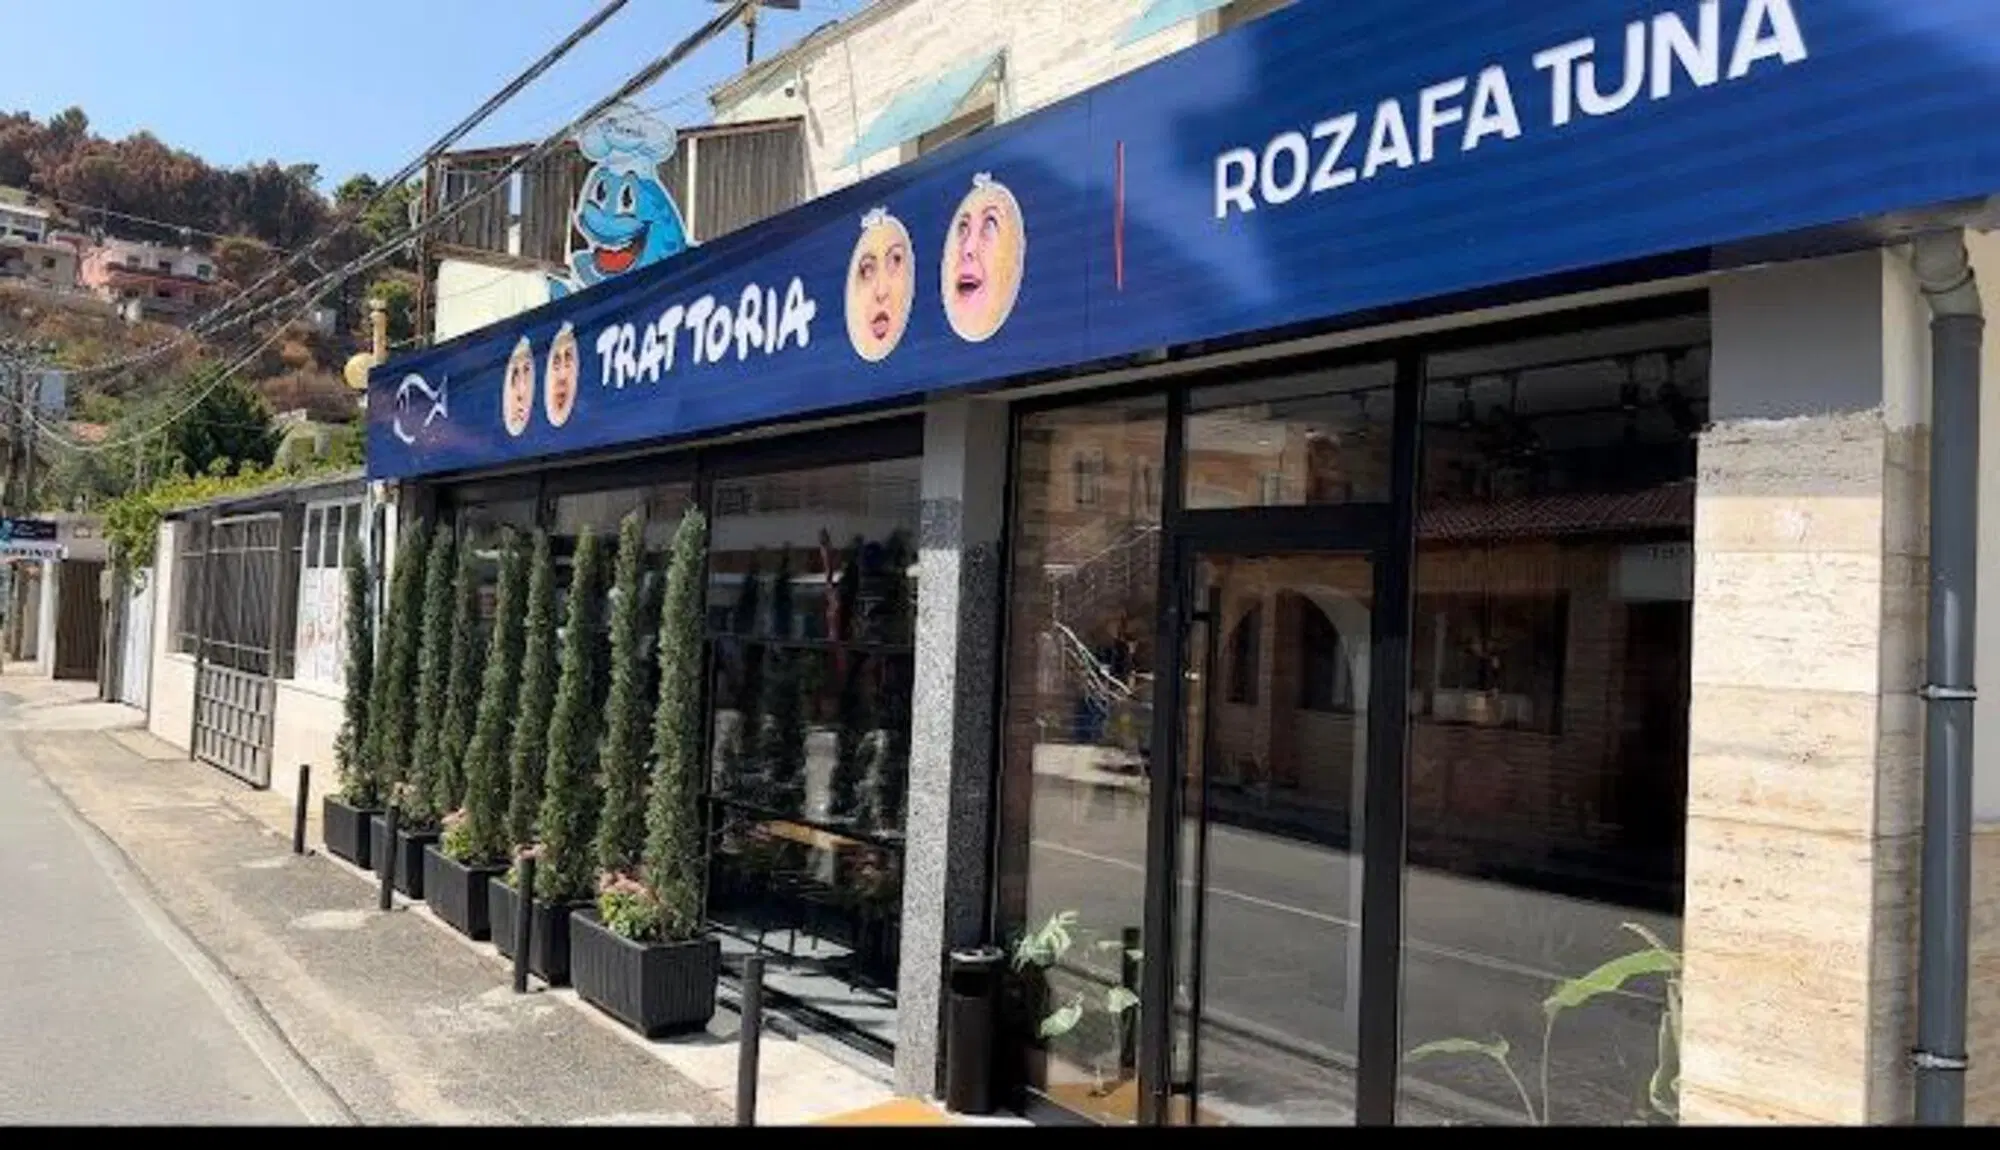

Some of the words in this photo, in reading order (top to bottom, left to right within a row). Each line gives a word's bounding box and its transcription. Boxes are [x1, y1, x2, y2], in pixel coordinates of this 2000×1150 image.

[1214, 64, 1522, 218] ROZAFA
[1533, 0, 1807, 127] TUNA
[596, 276, 817, 389] TRATTORIA
